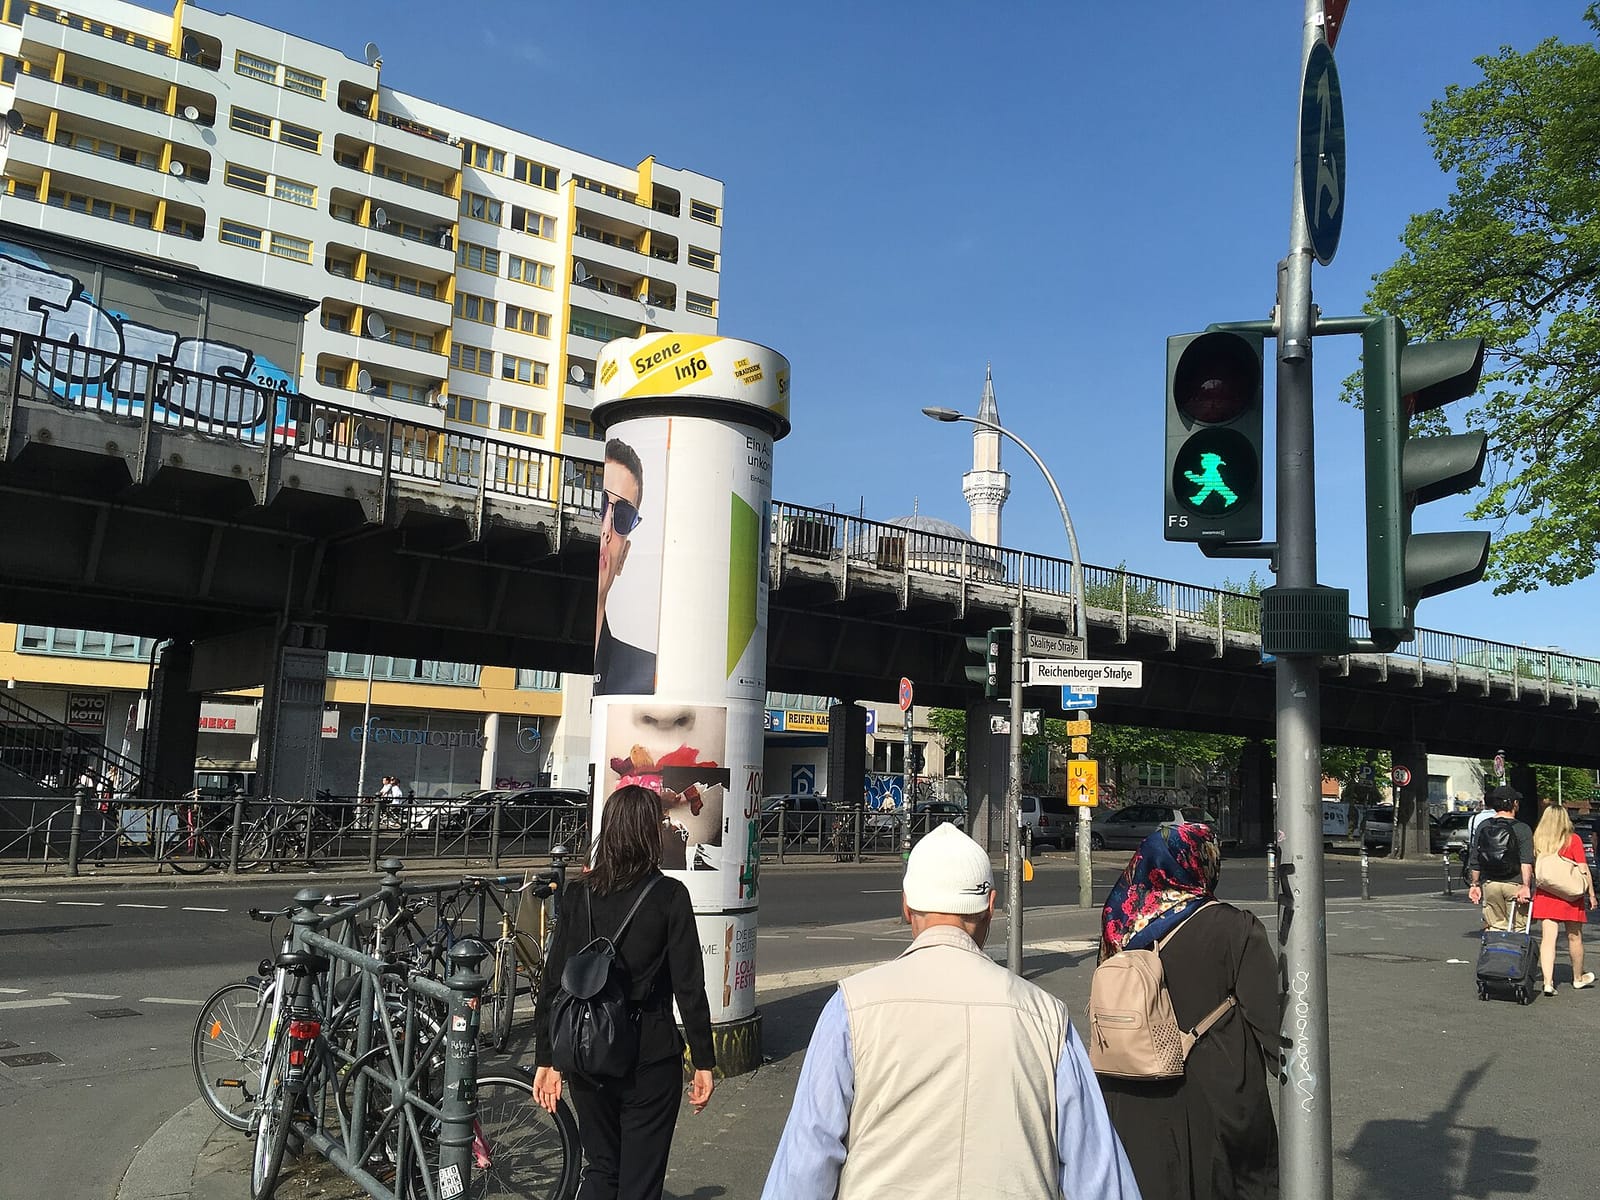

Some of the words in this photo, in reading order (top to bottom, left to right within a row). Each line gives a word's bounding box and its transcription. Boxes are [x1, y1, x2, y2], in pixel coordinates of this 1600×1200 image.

[635, 343, 682, 374] Szene
[675, 357, 707, 380] Info
[746, 436, 761, 452] Ein
[1168, 515, 1189, 528] F5
[1030, 635, 1057, 652] Skalitzer
[1058, 639, 1079, 656] Straße
[1038, 664, 1102, 681] Reichenberger
[1103, 666, 1133, 681] Straße
[71, 695, 105, 708] FOTO
[788, 713, 815, 725] REIFEN
[735, 958, 755, 976] LOLA
